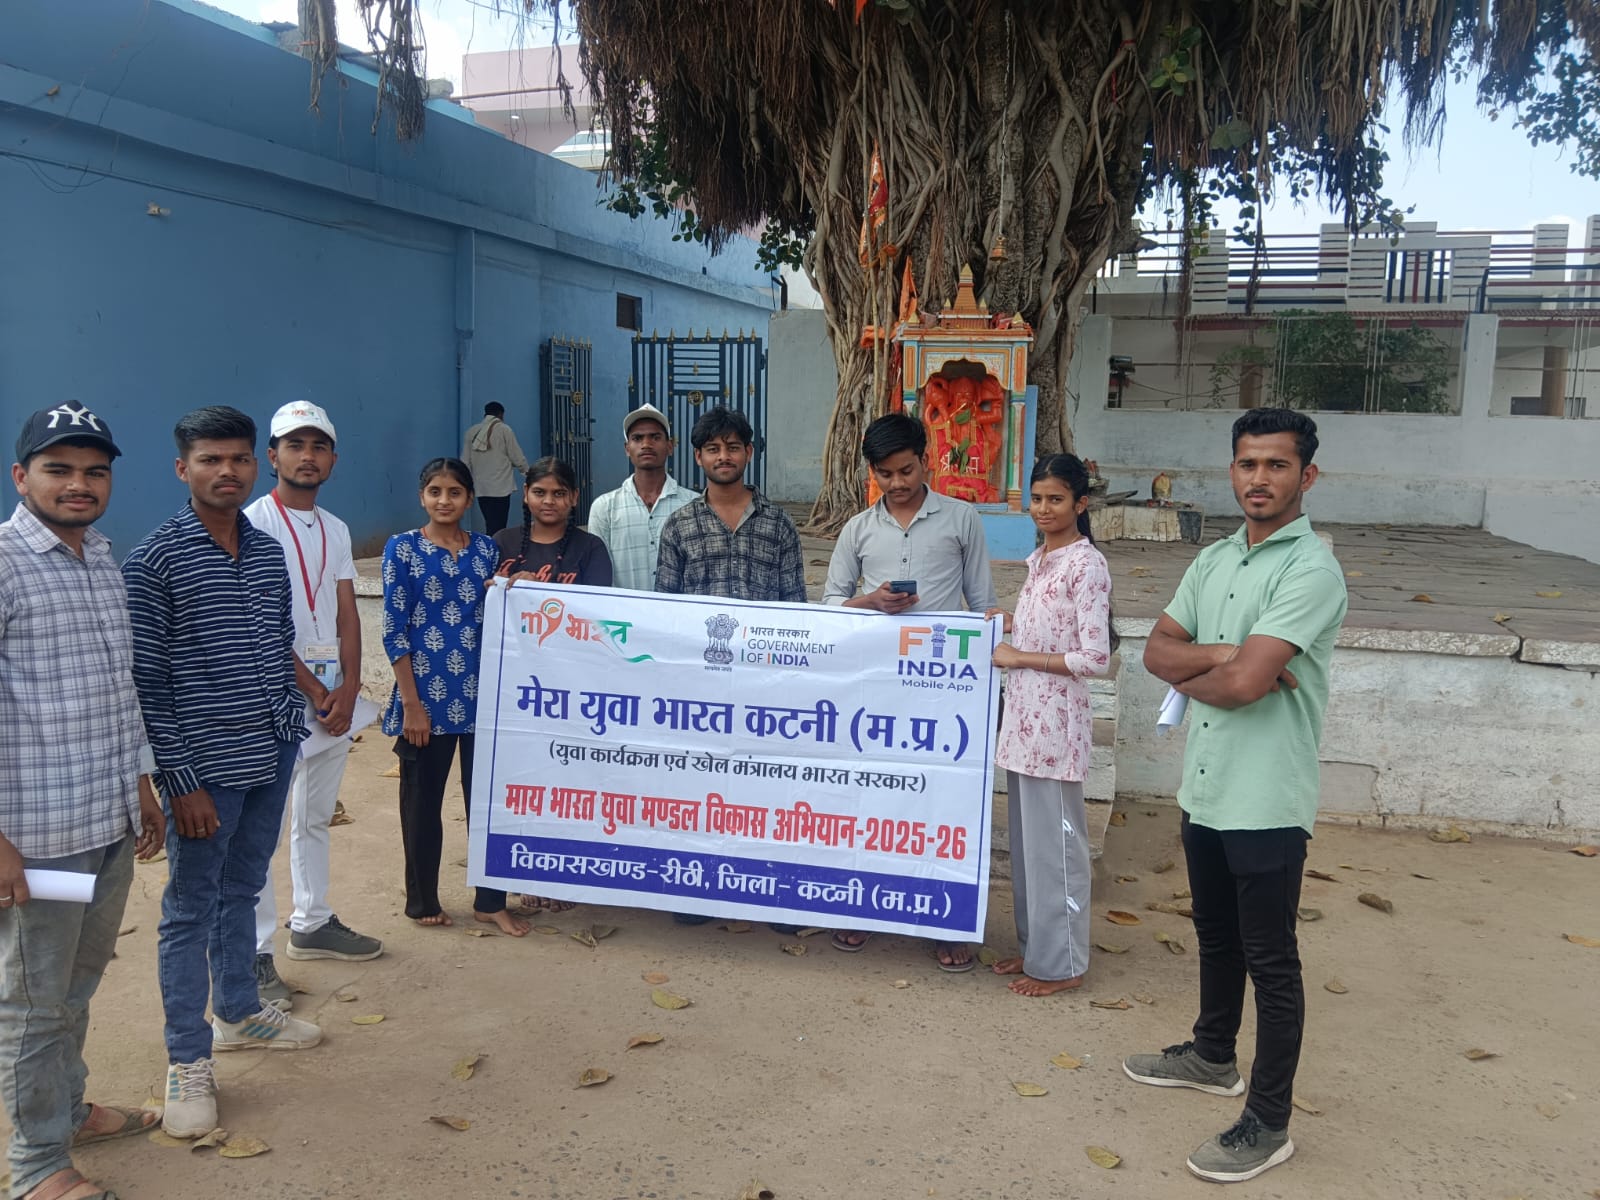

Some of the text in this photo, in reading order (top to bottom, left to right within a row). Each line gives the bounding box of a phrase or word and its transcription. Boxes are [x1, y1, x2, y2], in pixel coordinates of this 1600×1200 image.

[748, 638, 836, 655] GOVERNMENT
[750, 626, 811, 639] भारत सरकार
[899, 622, 982, 660] FIT
[747, 652, 810, 667] OF INDIA
[898, 659, 979, 681] INDIA
[902, 679, 974, 693] Mobile App
[517, 675, 969, 762] मेरा युवा भारत कटनी (म.प्र.)
[549, 740, 926, 794] (युवा कार्यक्रम एवं खेल मंत्रालय भारत सरकार)
[505, 784, 967, 861] माय भारत युवा मण्डल विकास अभियान-2025-26
[871, 884, 952, 919] (म.प्र.)
